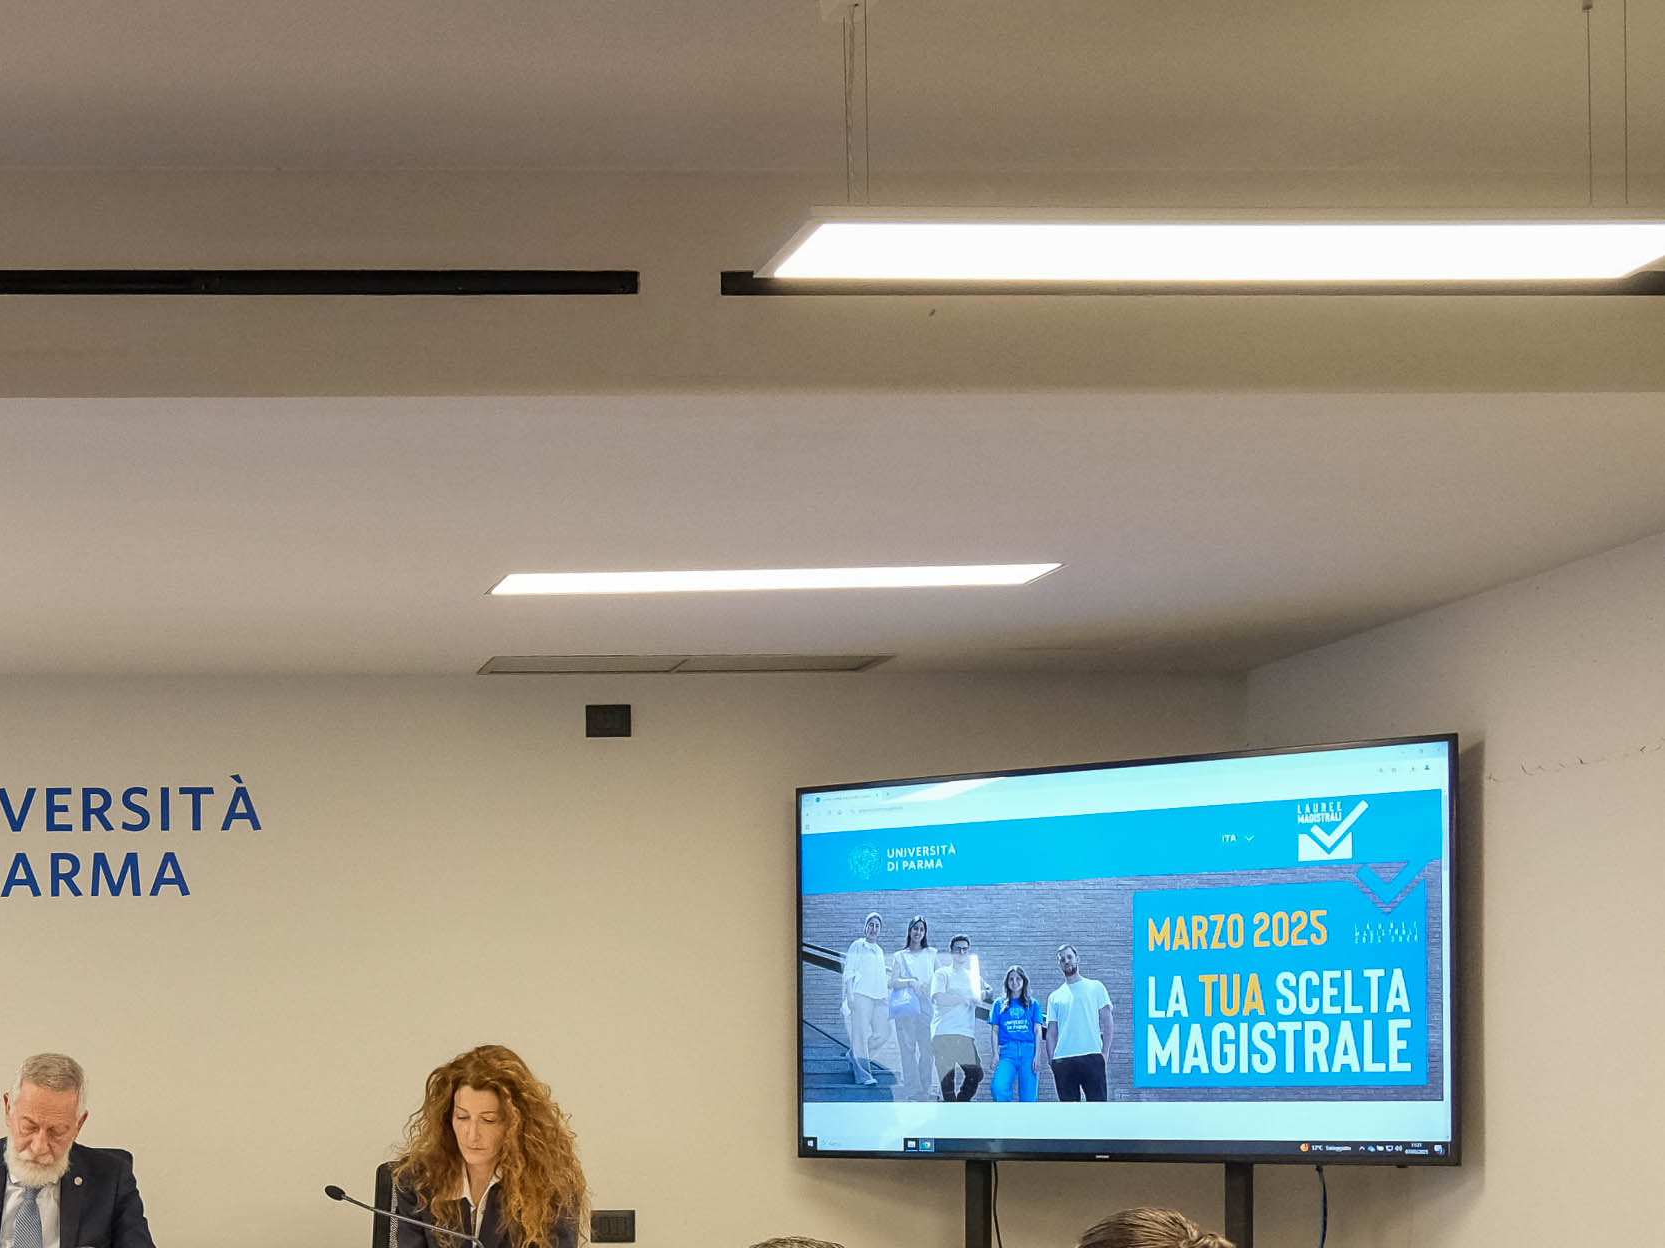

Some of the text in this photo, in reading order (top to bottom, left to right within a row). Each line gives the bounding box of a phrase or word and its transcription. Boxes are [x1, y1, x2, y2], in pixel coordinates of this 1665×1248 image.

[886, 842, 957, 859] UNIVERSITÀ
[1222, 834, 1237, 843] ITA
[887, 859, 944, 872] DI PARMA
[1148, 909, 1328, 951] MARZO 2025
[1148, 967, 1411, 1019] LA TUA SCELTA
[1147, 1018, 1413, 1075] MAGISTRALE
